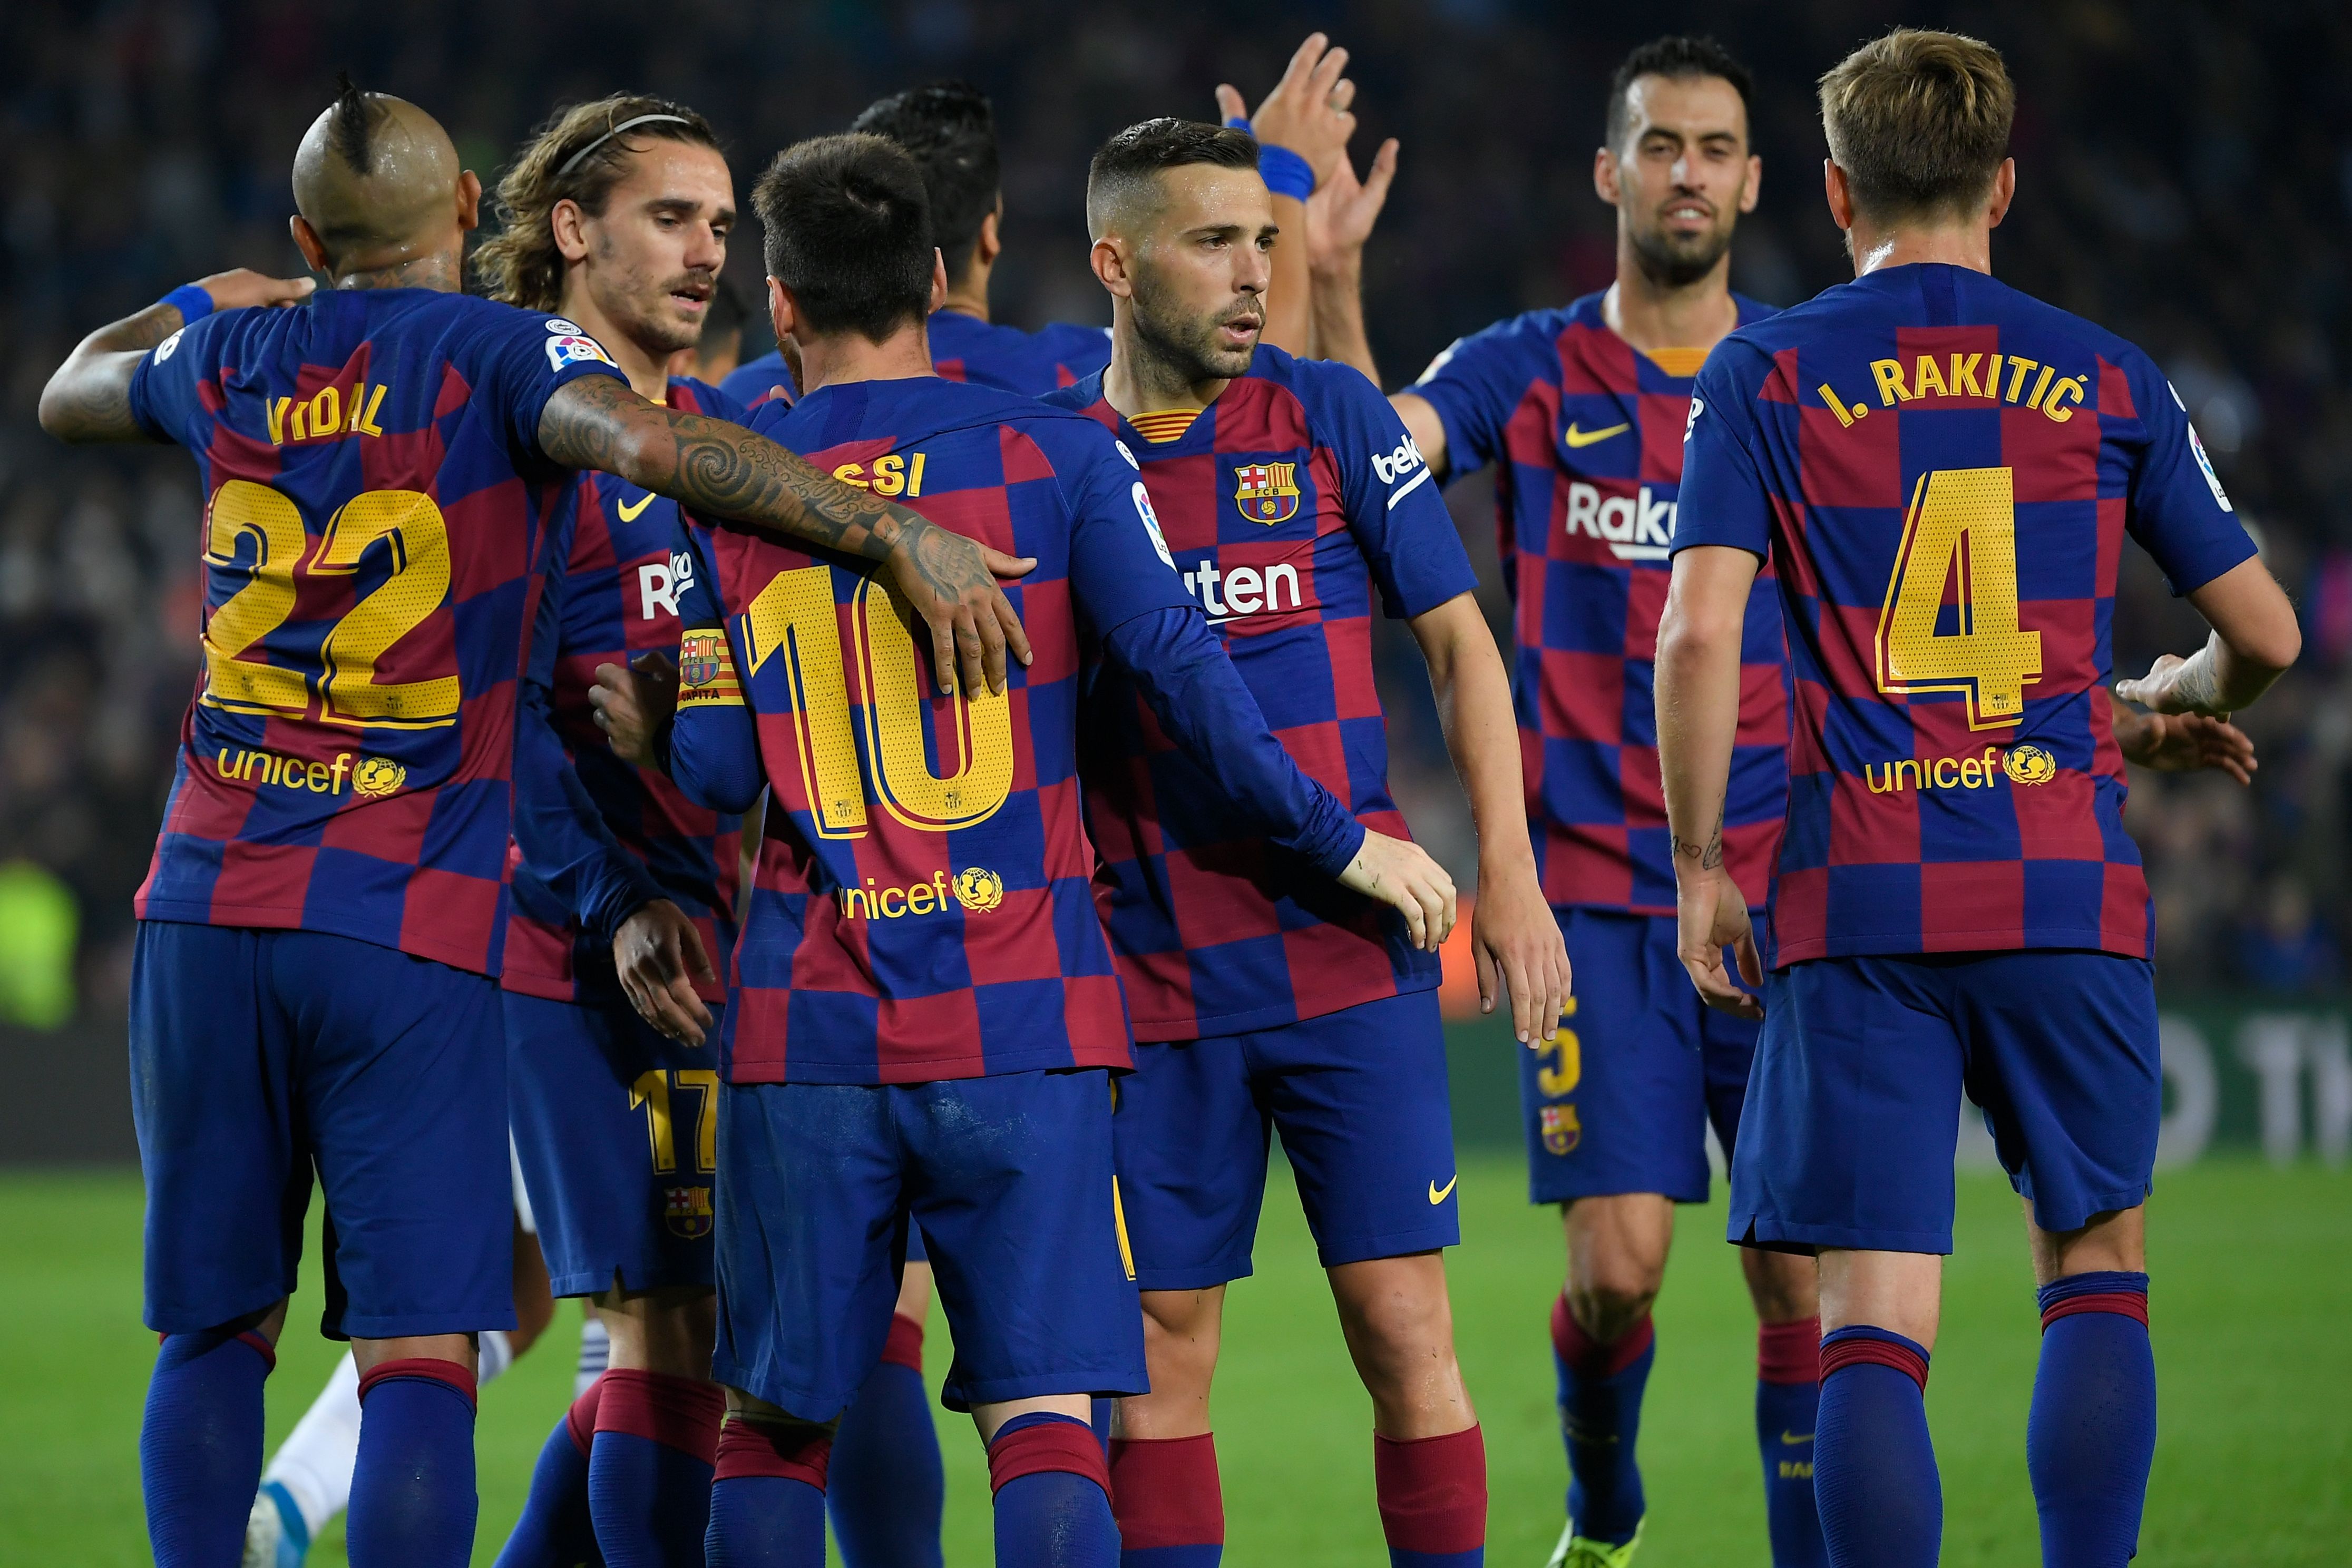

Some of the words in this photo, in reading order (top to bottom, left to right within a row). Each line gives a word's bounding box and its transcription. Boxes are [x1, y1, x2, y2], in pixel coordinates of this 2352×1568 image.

[266, 383, 387, 446] VIDAL
[1817, 383, 1869, 428] I.
[1869, 353, 2089, 423] RAKITIĆ
[833, 452, 926, 497] SSI
[1371, 434, 1425, 485] bek
[1565, 482, 1677, 546] Rak
[198, 479, 461, 730] 22
[1875, 466, 2042, 731] 4
[740, 563, 1014, 840] 10
[217, 747, 352, 796] unicef
[1865, 747, 1996, 793] unicef
[837, 870, 948, 920] nicef
[629, 1070, 718, 1175] 17
